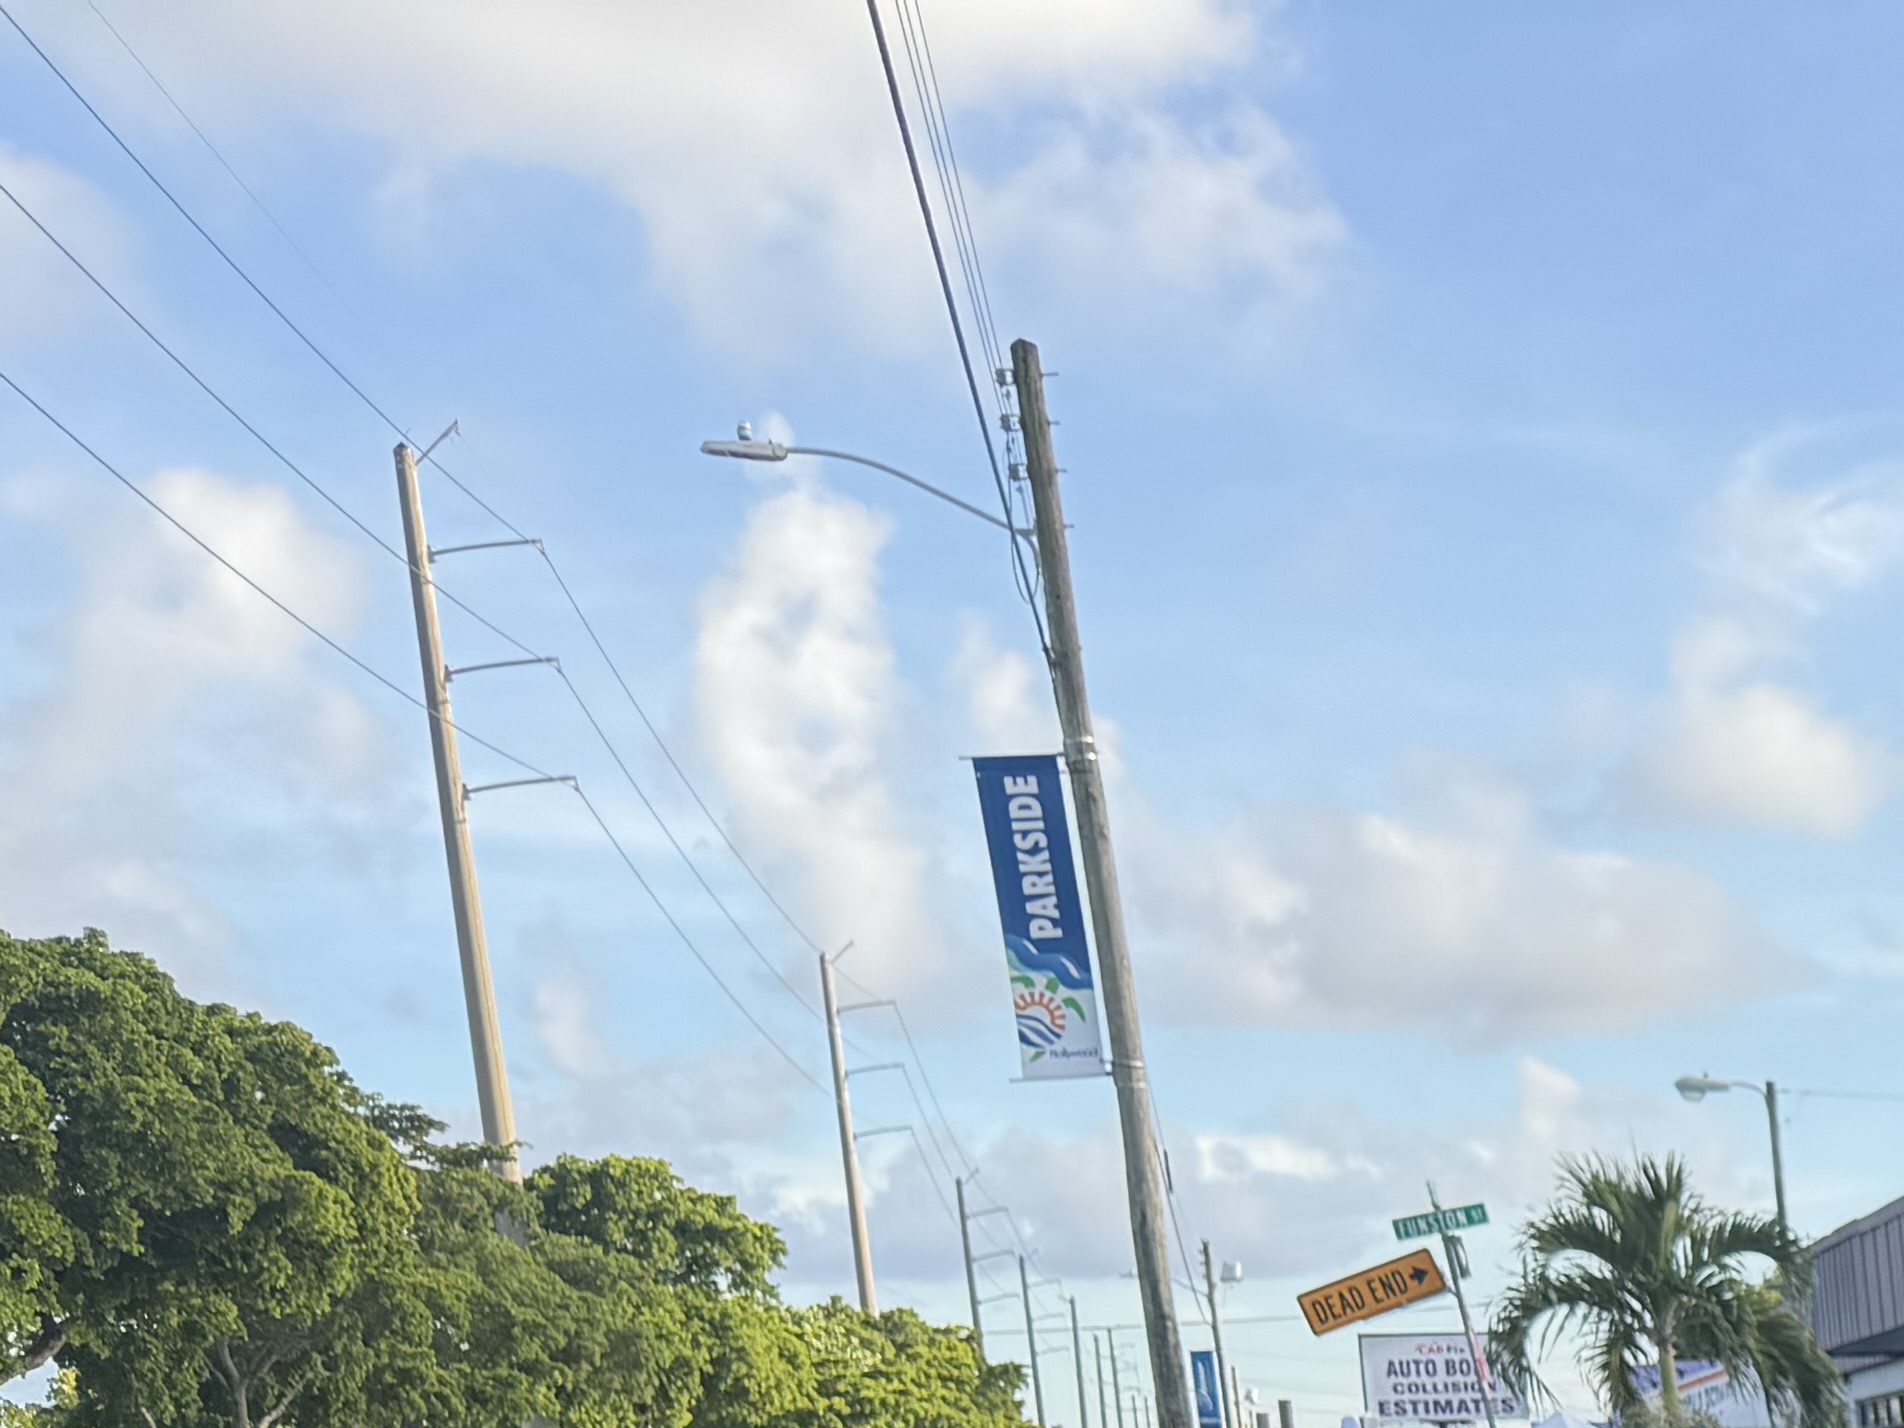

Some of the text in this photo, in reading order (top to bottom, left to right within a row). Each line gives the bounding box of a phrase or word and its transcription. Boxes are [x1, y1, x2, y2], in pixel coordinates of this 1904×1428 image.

[1004, 774, 1063, 940] PARKSIDE
[1311, 1269, 1408, 1325] DEAD END
[1386, 1358, 1437, 1379] AUTO
